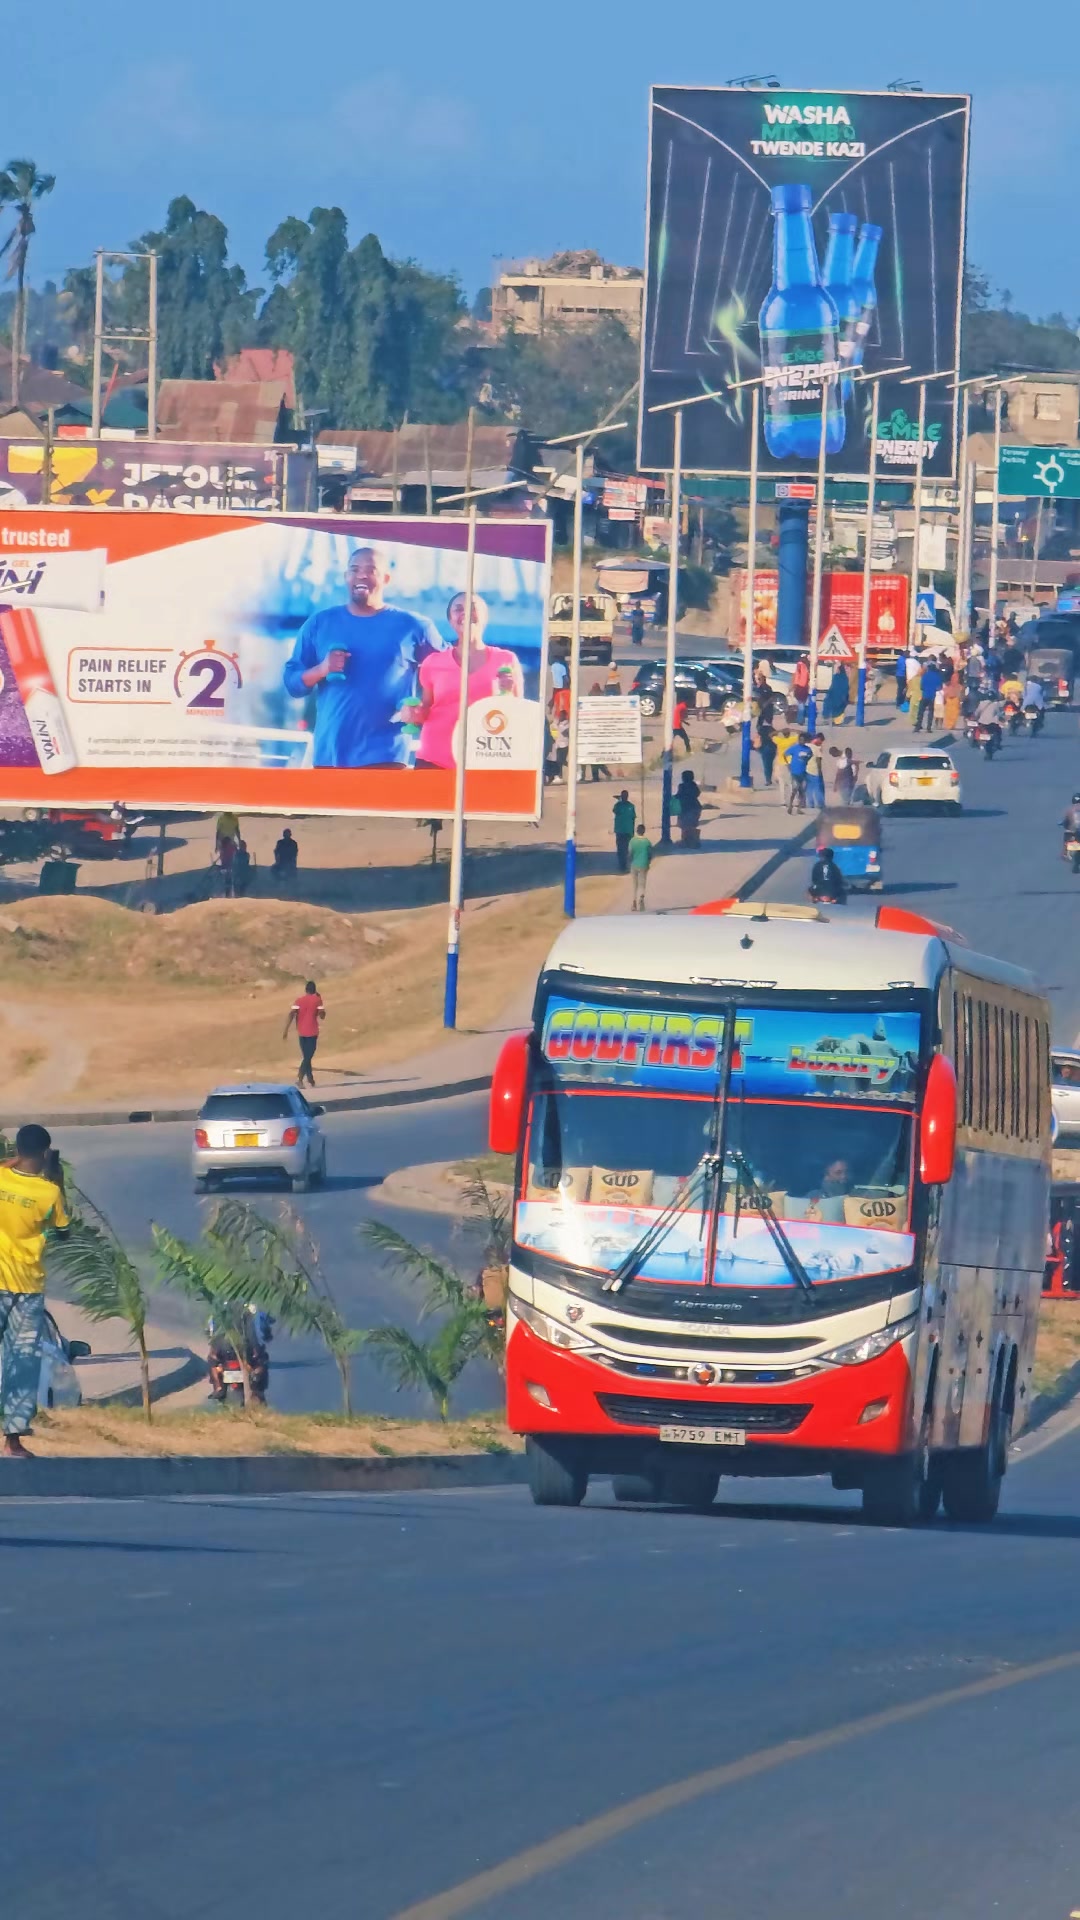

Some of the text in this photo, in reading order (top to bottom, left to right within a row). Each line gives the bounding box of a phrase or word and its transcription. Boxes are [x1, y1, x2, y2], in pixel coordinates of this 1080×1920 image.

[763, 104, 851, 125] WASHA
[750, 140, 866, 157] TWENDE KAZI
[867, 421, 942, 441] EMBE
[121, 462, 259, 492] JETOUR
[1, 527, 71, 547] trusted
[79, 658, 167, 673] PAIN RELIEF
[78, 678, 152, 693] STARTS IN
[186, 658, 227, 707] 2
[475, 736, 513, 751] SUN
[541, 1008, 754, 1073] GODFIRST
[859, 1200, 897, 1218] GOD
[713, 1430, 741, 1444] EMT
